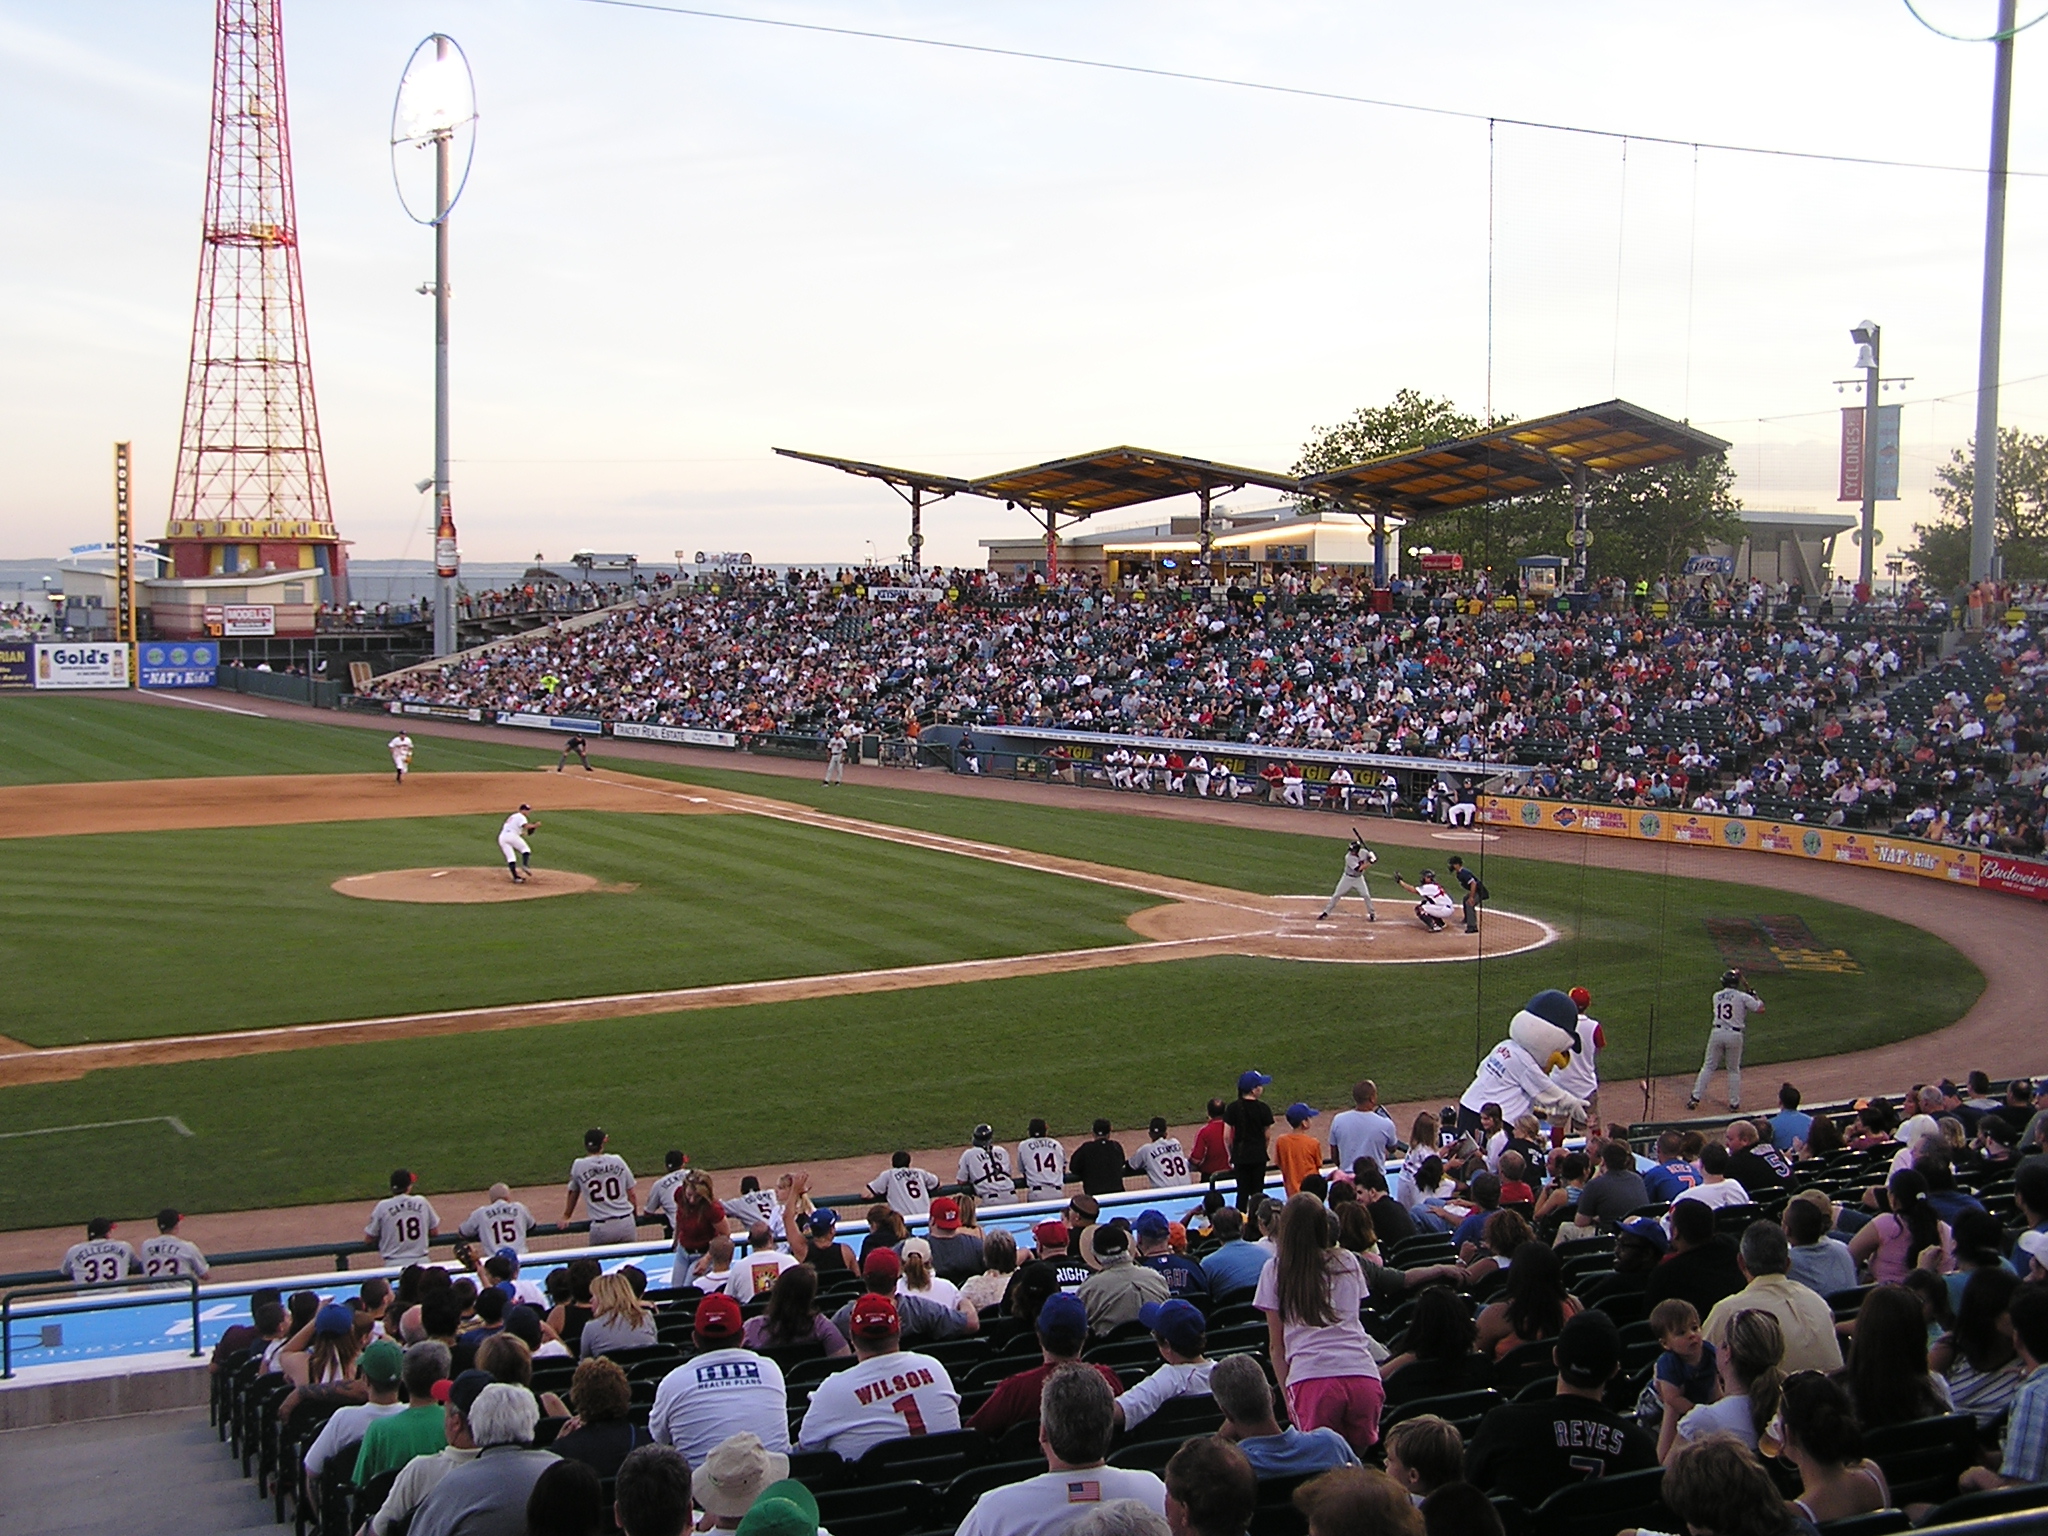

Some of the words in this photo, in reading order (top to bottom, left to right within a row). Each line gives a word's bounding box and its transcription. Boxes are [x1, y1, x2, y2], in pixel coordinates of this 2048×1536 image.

[118, 457, 127, 511] NORTH
[119, 525, 128, 567] FORK
[120, 579, 129, 622] BANK
[54, 649, 110, 664] Gold's
[616, 725, 640, 736] TRACEY
[642, 726, 659, 738] REAL
[661, 728, 685, 740] ESTATE
[1582, 816, 1600, 829] ARE
[1874, 846, 1912, 865] "NAT's
[1913, 852, 1939, 870] Kids"
[1717, 1003, 1733, 1020] 13
[1028, 1139, 1057, 1150] CUSICK
[1033, 1152, 1057, 1173] 14
[1160, 1156, 1186, 1177] 38
[1764, 1153, 1791, 1178] 5
[580, 1165, 624, 1183] LEONHARDT
[1678, 1175, 1696, 1188] 7
[588, 1177, 621, 1203] 20
[905, 1180, 921, 1199] 6
[388, 1201, 423, 1217] GAMBLE
[757, 1202, 773, 1220] 5
[396, 1216, 421, 1243] 18
[491, 1219, 517, 1245] 15
[147, 1244, 180, 1257] SWEET
[84, 1257, 118, 1283] 33
[147, 1257, 180, 1276] 23
[1056, 1267, 1090, 1283] RIGHT
[698, 1362, 759, 1382] HIP
[698, 1381, 731, 1390] HEALTH
[734, 1379, 762, 1387] PLANS
[854, 1368, 935, 1406] WILSON
[891, 1394, 928, 1437] 1
[1553, 1420, 1624, 1455] REYES
[1569, 1455, 1605, 1480] 7
